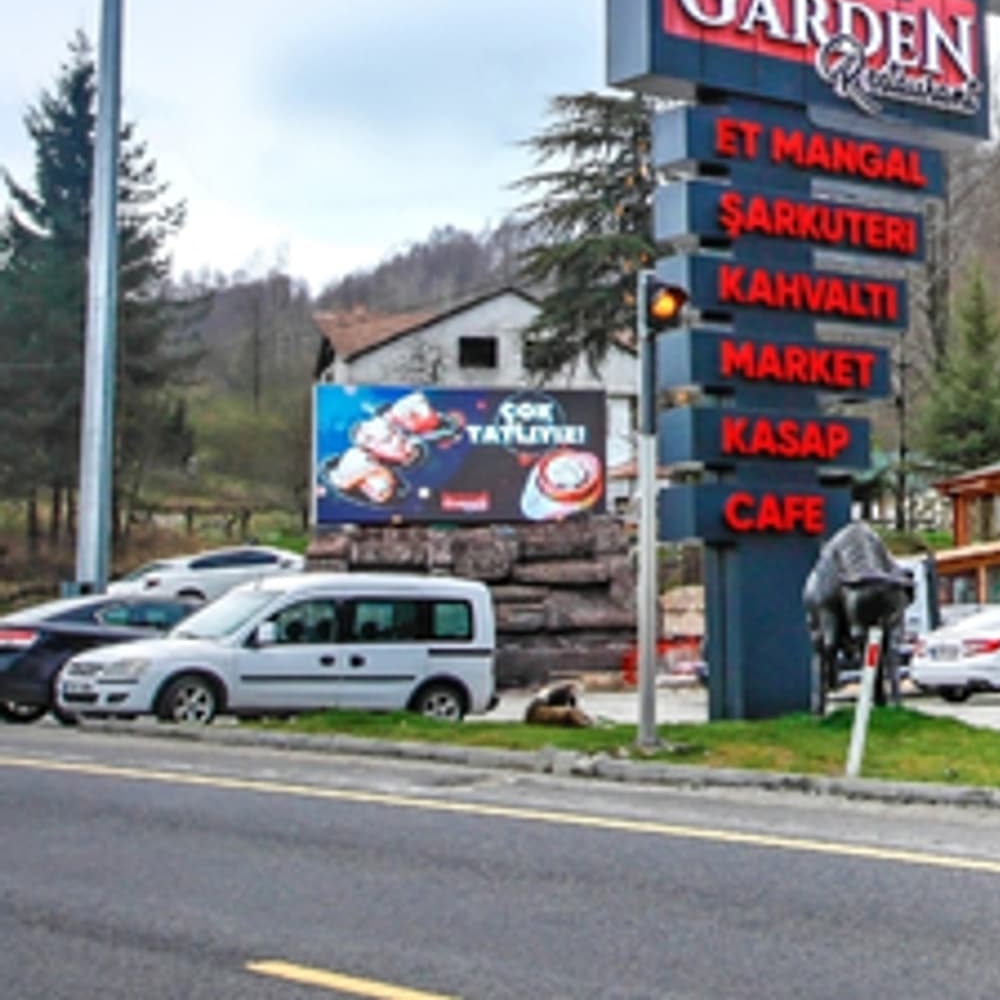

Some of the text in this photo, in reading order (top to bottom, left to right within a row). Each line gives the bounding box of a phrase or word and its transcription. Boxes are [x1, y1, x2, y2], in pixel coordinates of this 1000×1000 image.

[714, 117, 928, 188] ET MANGAL
[718, 264, 897, 321] KAHVALTI
[719, 340, 876, 388] MARKET
[721, 416, 850, 458] KASAP
[723, 492, 826, 535] CAFE
